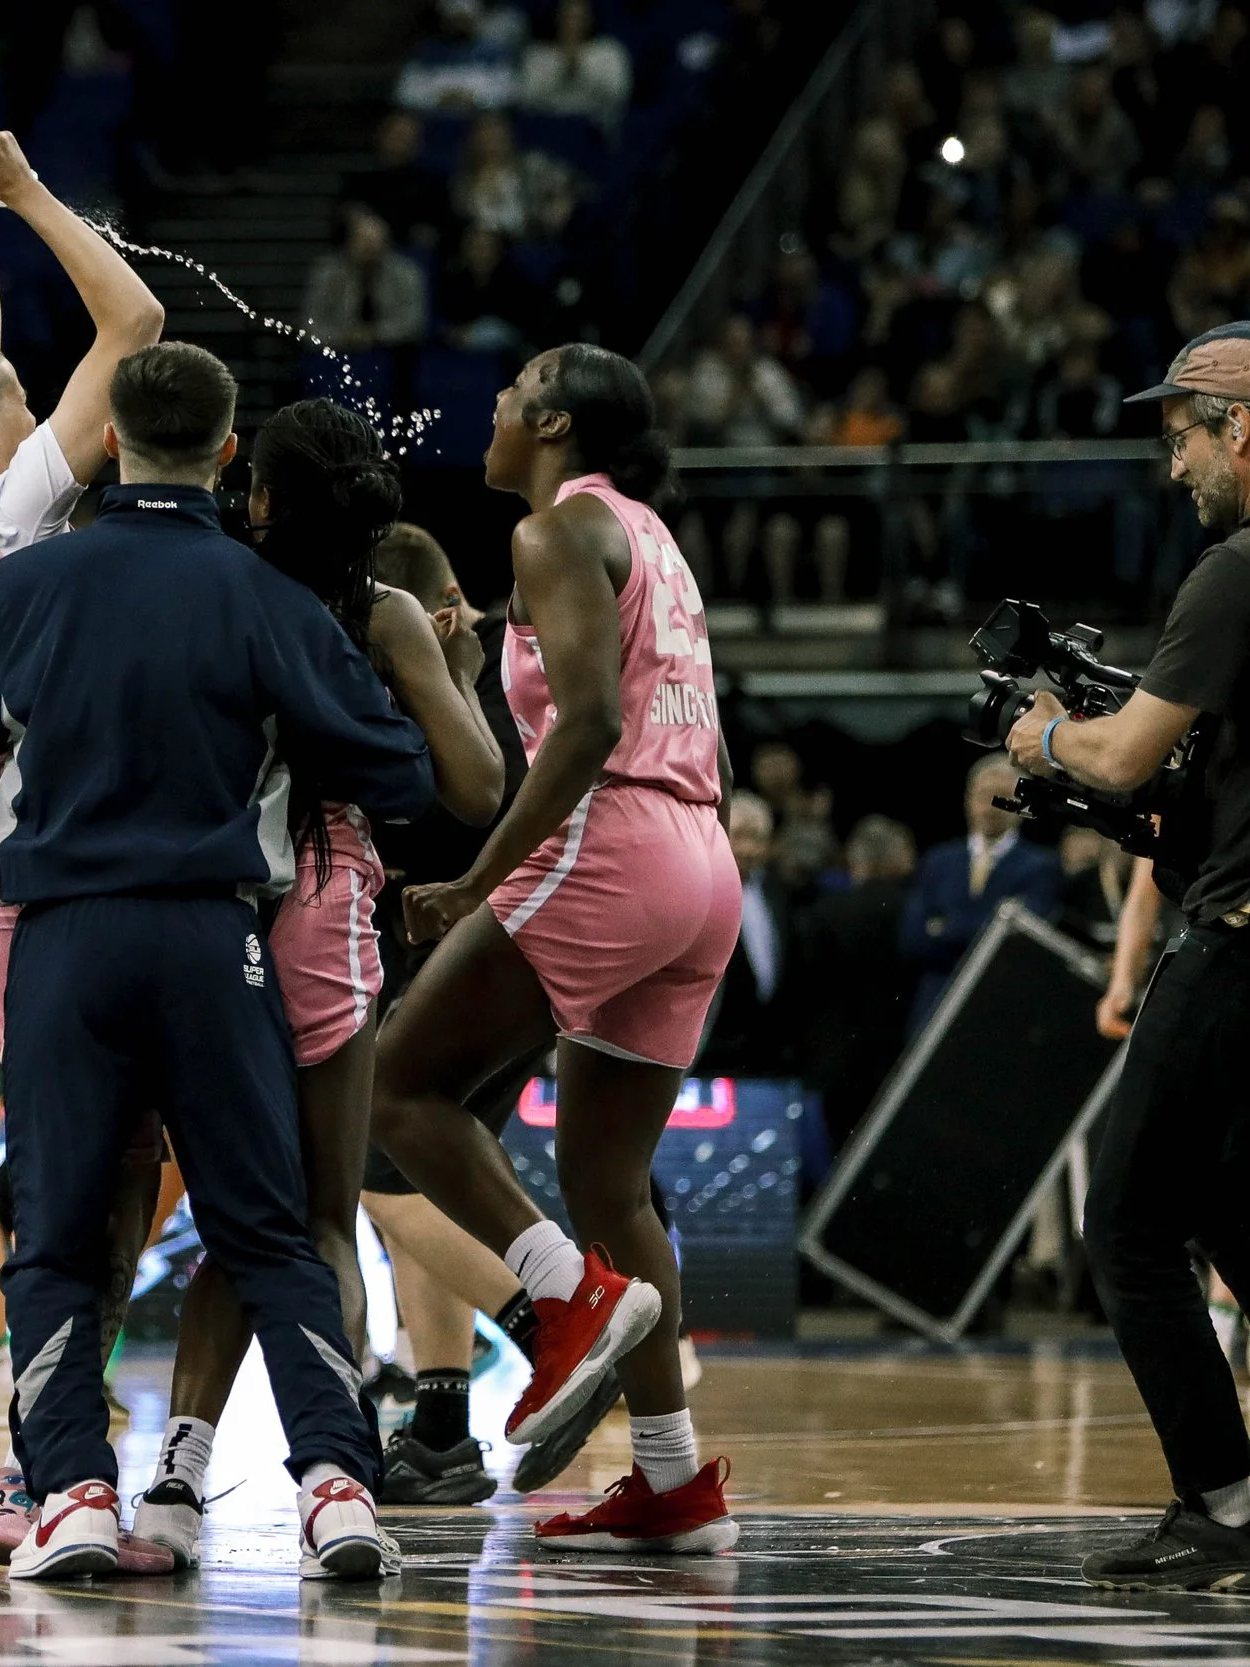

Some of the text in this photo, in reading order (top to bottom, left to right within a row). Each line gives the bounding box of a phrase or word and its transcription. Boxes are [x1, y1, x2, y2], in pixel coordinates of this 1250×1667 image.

[137, 499, 178, 509] Reebok
[243, 964, 264, 976] SUPER
[333, 1480, 350, 1489] NIKE
[88, 1486, 105, 1494] NIKE
[1154, 1547, 1198, 1565] MERRELL
